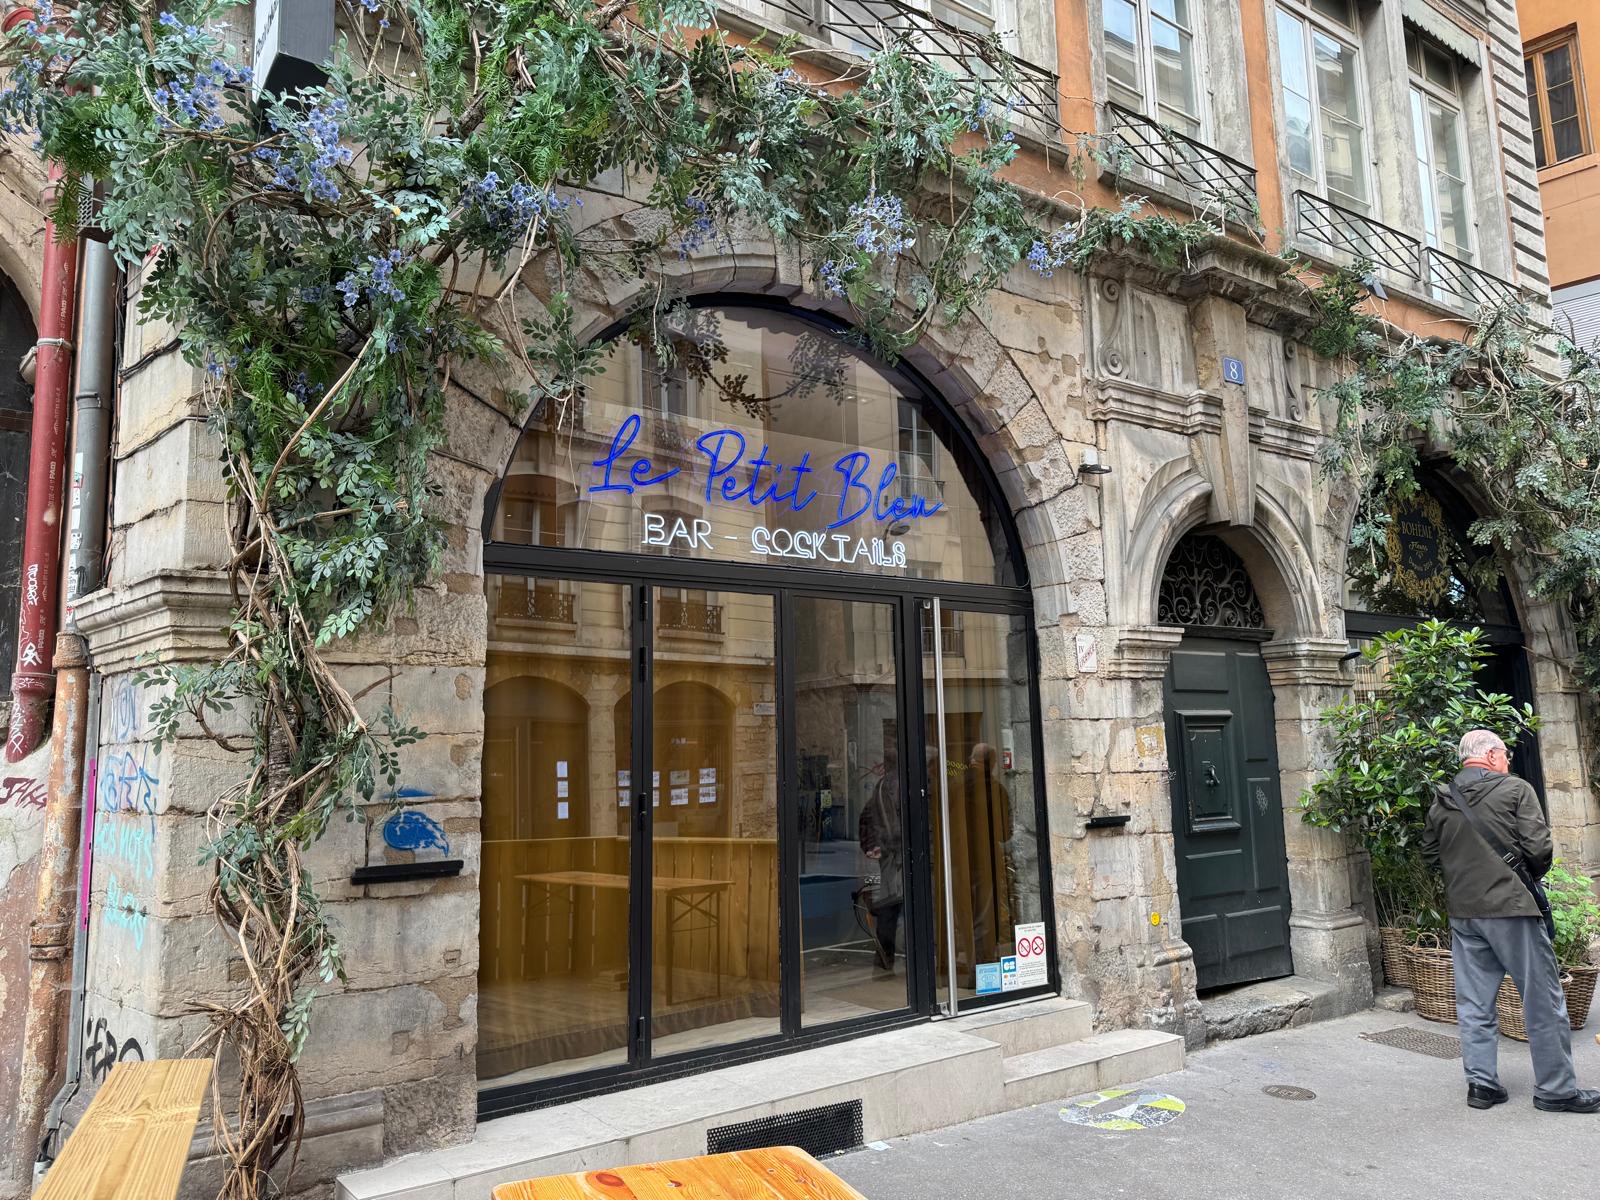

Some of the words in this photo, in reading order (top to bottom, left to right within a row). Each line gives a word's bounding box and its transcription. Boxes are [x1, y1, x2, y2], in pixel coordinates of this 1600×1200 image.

[1229, 361, 1239, 380] 8
[589, 414, 681, 494] Le
[696, 429, 818, 512] Petit
[642, 513, 713, 550] BAR
